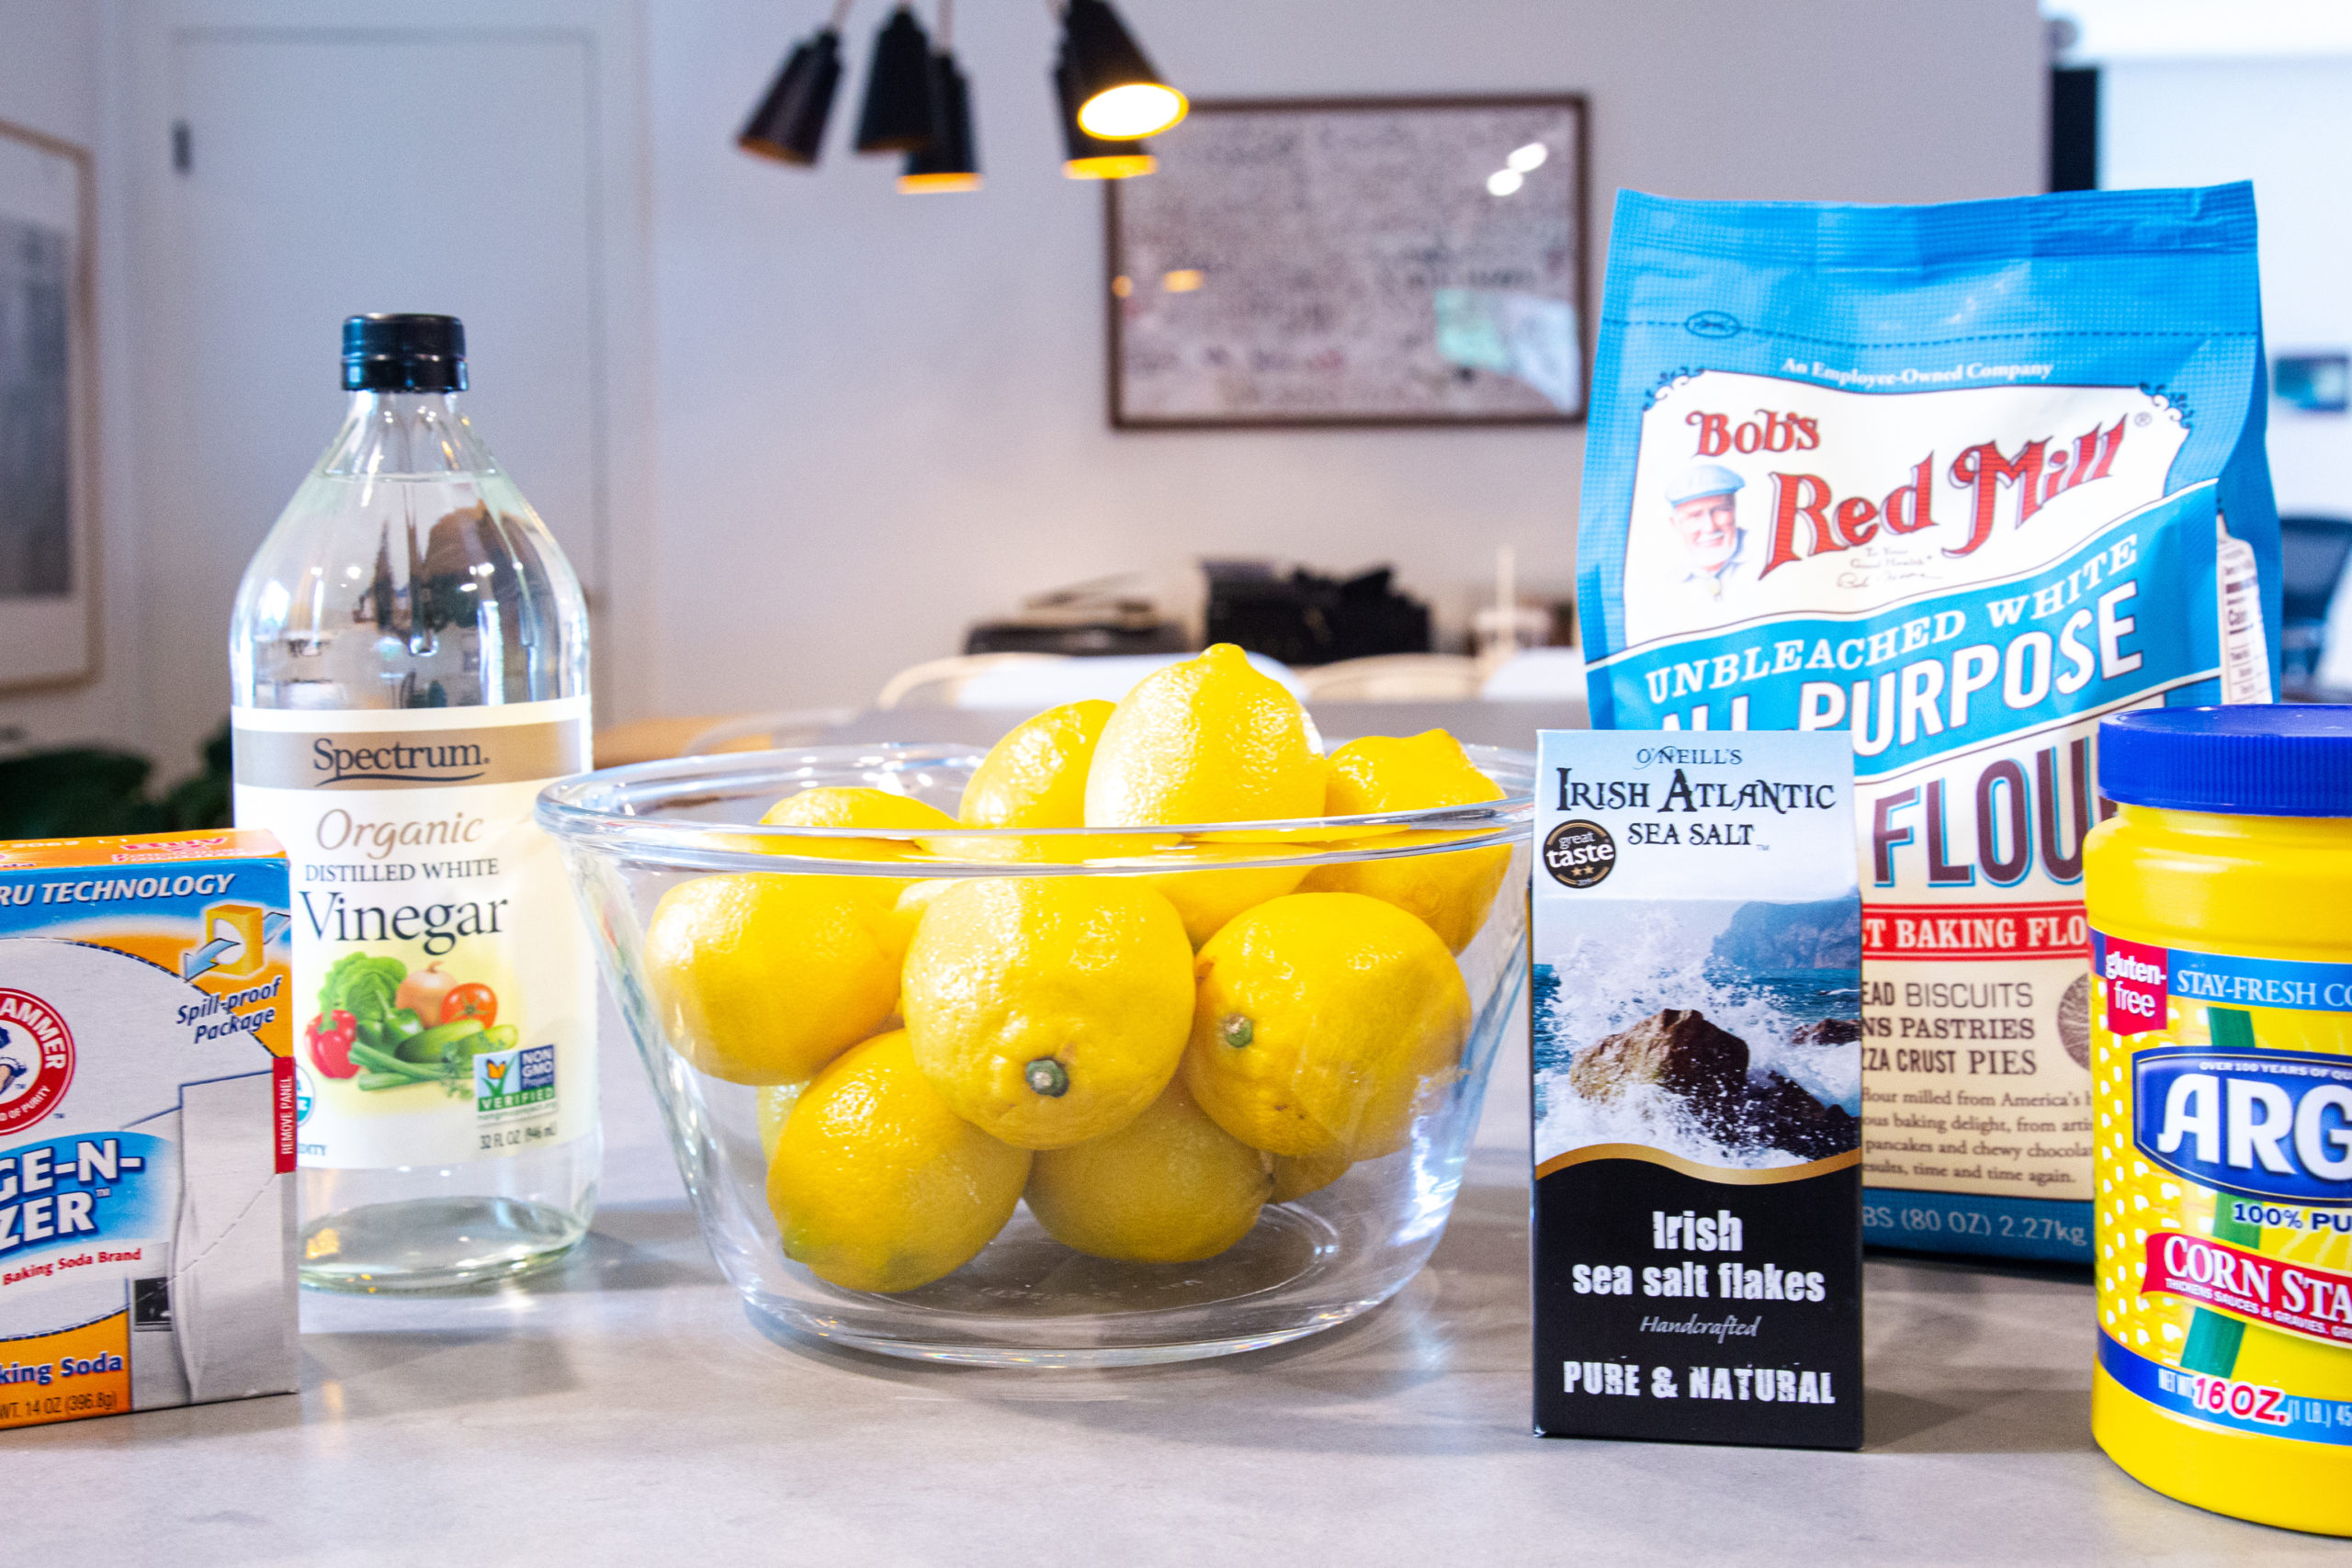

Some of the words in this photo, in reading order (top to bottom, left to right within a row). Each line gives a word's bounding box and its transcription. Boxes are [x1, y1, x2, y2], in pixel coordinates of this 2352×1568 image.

[1782, 357, 1808, 373] An
[1812, 361, 1963, 389] Employee-Owned
[1966, 361, 2054, 380] Company
[1685, 409, 1820, 458] Bob's
[1758, 450, 1939, 581] Red
[1941, 412, 2128, 559] Mill
[1645, 609, 1966, 705] UNBLEACHED
[1986, 532, 2139, 628] WHITE
[1556, 767, 1651, 811] IRISH
[1657, 768, 1837, 815] ATLANTIC
[1872, 736, 2119, 888] FLOU
[315, 808, 485, 860] Organic
[1558, 830, 1596, 850] great
[1627, 822, 1680, 845] SEA
[1689, 823, 1755, 846] SALT
[305, 863, 415, 882] DISTILLED
[421, 858, 499, 879] WHITE
[1545, 843, 1615, 868] taste
[0, 885, 34, 907] RU
[42, 873, 236, 903] TECHNOLOGY
[298, 890, 510, 956] Vinegar
[1895, 917, 2018, 949] BAKING
[2027, 915, 2087, 947] FLO
[175, 975, 283, 1026] Spill-proof
[1861, 981, 1895, 1007] EAD
[1905, 982, 2034, 1009] BISCUITS
[2114, 980, 2156, 1019] free
[2177, 969, 2317, 1006] STAY-FRESH
[0, 997, 68, 1070] AMMER
[193, 1007, 277, 1044] Package
[1861, 1017, 1893, 1038] NS
[1899, 1017, 2036, 1040] PASTRIES
[522, 1048, 552, 1065] NON
[522, 1060, 553, 1077] GMO
[1861, 1047, 1891, 1072] ZZA
[1895, 1048, 1956, 1074] CRUST
[1968, 1049, 2038, 1076] PIES
[2199, 1061, 2233, 1071] OVER
[2260, 1063, 2308, 1077] YEARS
[2309, 1066, 2331, 1077] OF
[2331, 1069, 2352, 1080] QU
[279, 1076, 293, 1110] PANEL
[481, 1087, 554, 1110] VERIFIED
[1903, 1089, 1952, 1105] milled
[1957, 1089, 1996, 1107] from
[2001, 1090, 2081, 1107] America's
[279, 1111, 294, 1155] REMOVE
[1861, 1116, 1889, 1127] ous
[1894, 1112, 1948, 1134] baking
[1951, 1114, 2011, 1136] delight,
[2017, 1116, 2057, 1132] from
[2157, 1072, 2352, 1182] ARG
[1865, 1137, 1934, 1154] pancakes
[1938, 1140, 1968, 1155] and
[1972, 1141, 2023, 1161] chewy
[0, 1139, 141, 1199] GE-N-
[1861, 1159, 1909, 1176] esults,
[1913, 1162, 1950, 1177] time
[1952, 1165, 1983, 1179] and
[1986, 1167, 2024, 1181] time
[2028, 1168, 2077, 1187] again.
[0, 1190, 95, 1251] ZER
[1652, 1209, 1744, 1252] Irish
[1862, 1205, 1894, 1228] BS
[1901, 1207, 1942, 1232] (80
[1948, 1211, 1992, 1236] OZ)
[1998, 1214, 2088, 1247] 2.27kg
[2233, 1202, 2303, 1229] 100%
[2311, 1212, 2352, 1233] PU
[2, 1262, 54, 1286] Baking
[57, 1253, 94, 1270] Soda
[97, 1247, 142, 1263] Brand
[1572, 1263, 1634, 1295] sea
[1642, 1261, 1710, 1298] salt
[1718, 1262, 1826, 1303] flakes
[2164, 1235, 2273, 1303] CORN
[2282, 1269, 2352, 1325] STA
[2213, 1290, 2260, 1315] SAUCES
[2261, 1306, 2273, 1319] &
[1639, 1313, 1762, 1344] Handcrafted
[0, 1360, 54, 1385] king
[60, 1350, 123, 1378] Soda
[1563, 1360, 1641, 1397] PURE
[1650, 1366, 1679, 1399] &
[1689, 1366, 1836, 1404] NATURAL
[25, 1399, 41, 1416] 14
[43, 1396, 62, 1415] OZ
